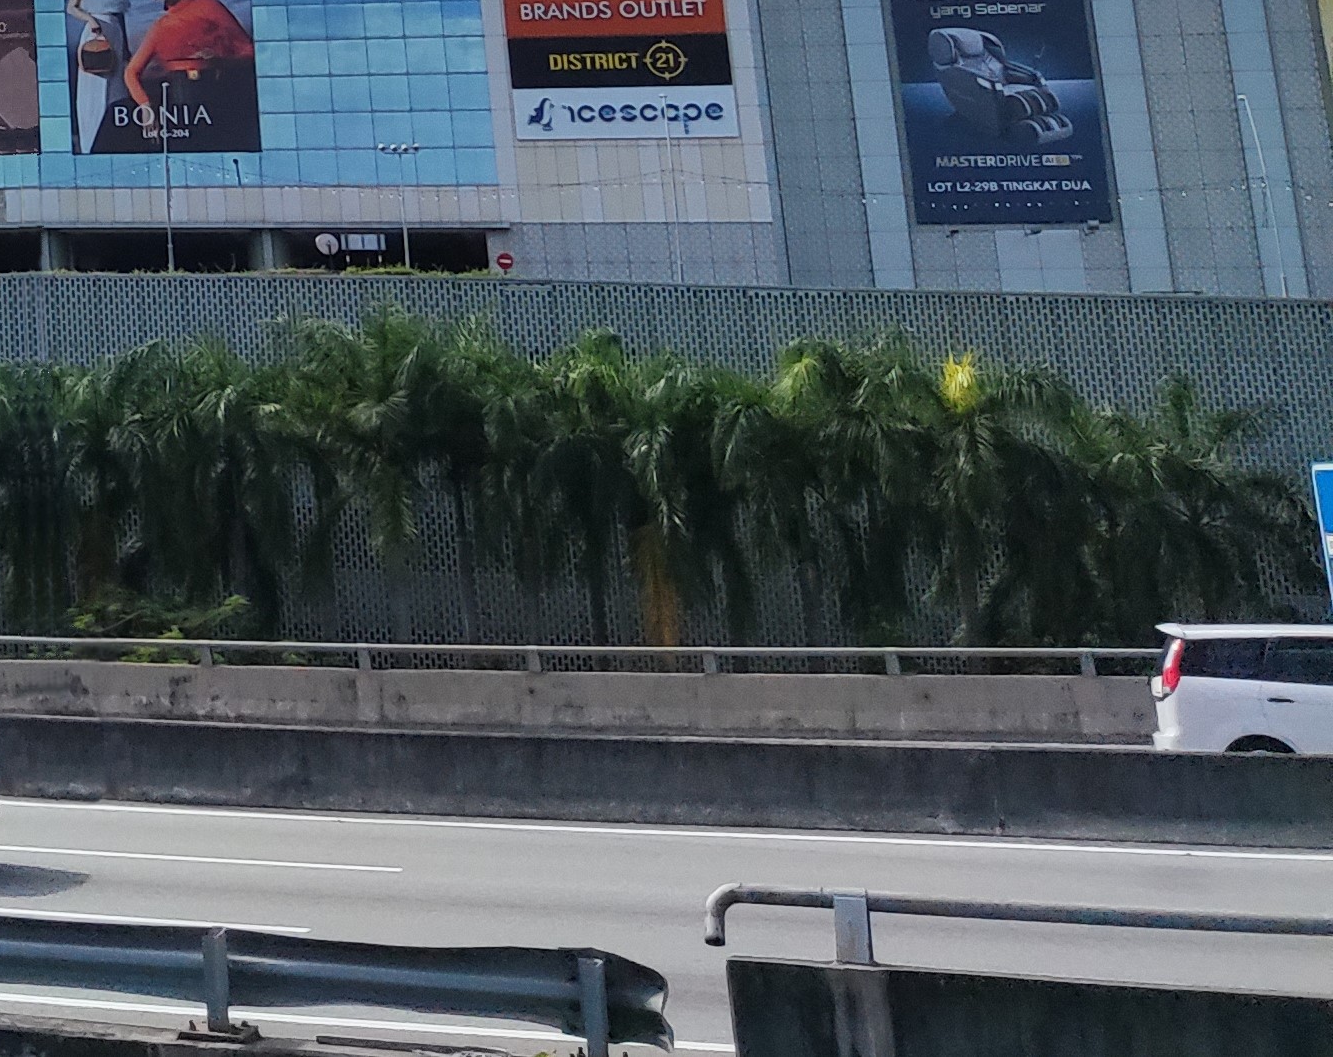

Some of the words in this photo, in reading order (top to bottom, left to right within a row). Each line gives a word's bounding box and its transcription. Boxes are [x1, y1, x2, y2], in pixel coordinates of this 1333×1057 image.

[519, 0, 613, 21] BRANDS
[930, 5, 972, 19] yang
[974, 3, 1047, 16] Sebenar
[548, 52, 640, 71] DISTRICT
[654, 52, 675, 68] 21
[113, 104, 213, 127] BONIA
[935, 154, 1042, 168] MASTERDRIVE
[927, 181, 953, 193] LOT
[956, 180, 999, 192] L2-29B
[1001, 180, 1059, 192] TINGKAT
[1061, 179, 1092, 191] DUA
